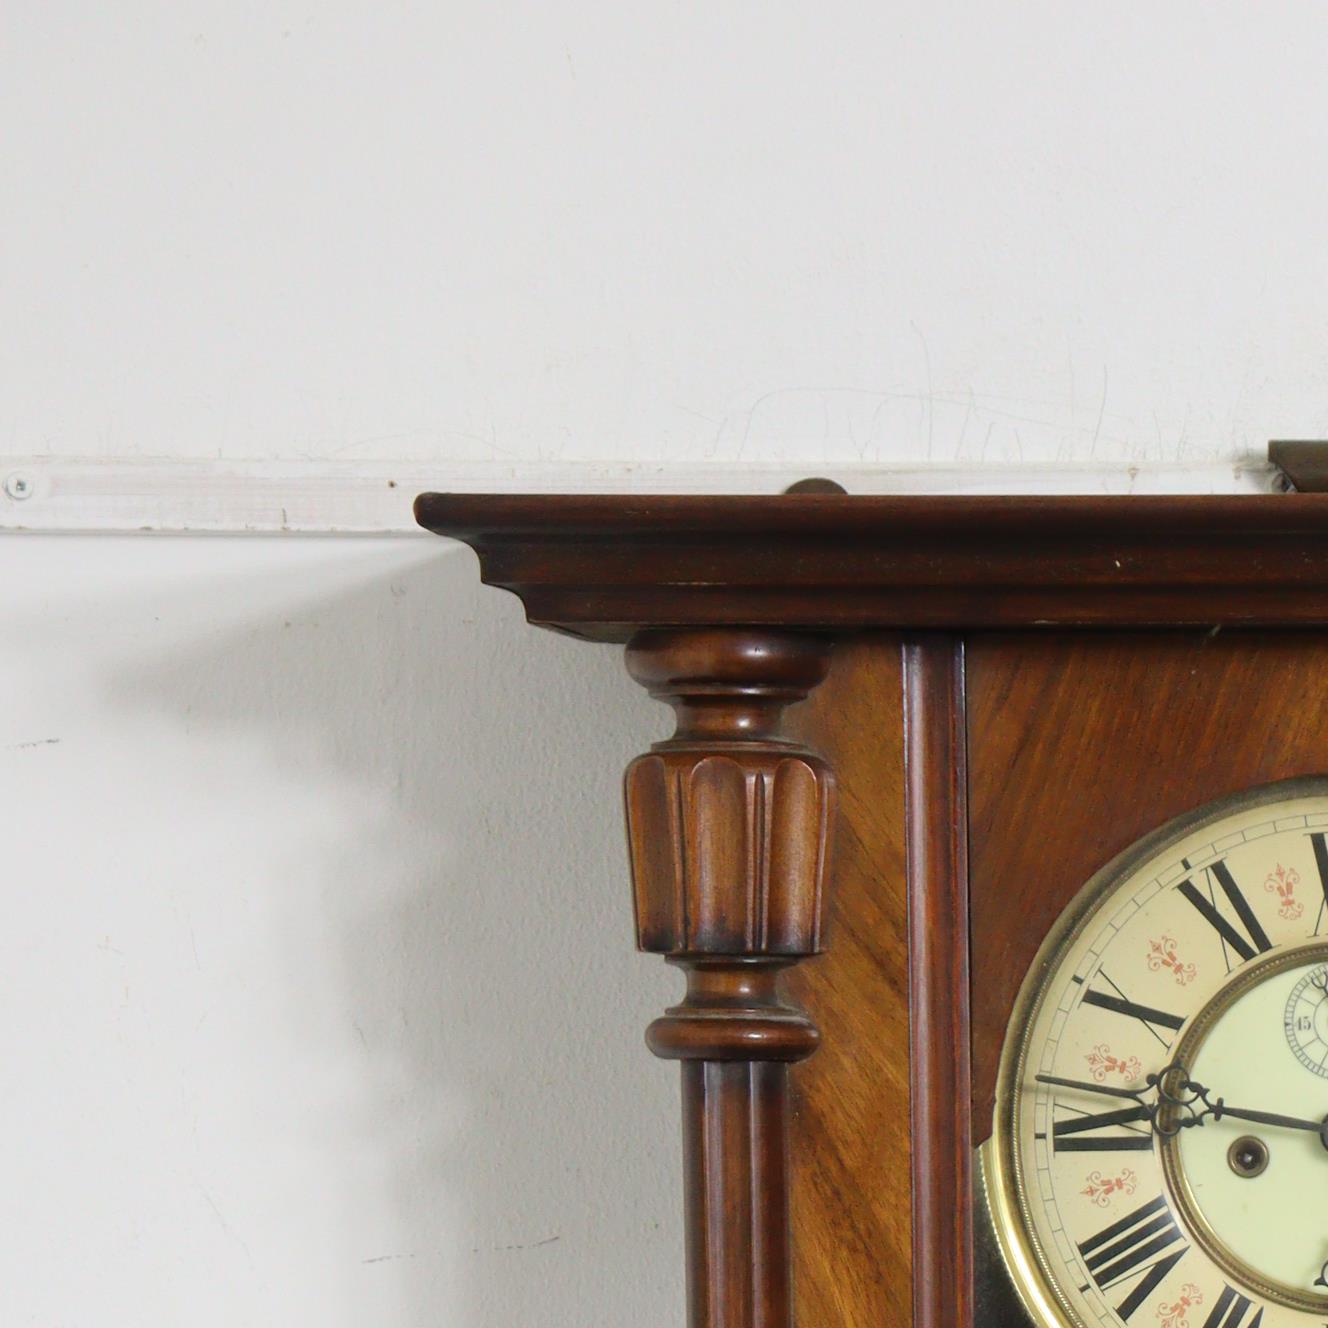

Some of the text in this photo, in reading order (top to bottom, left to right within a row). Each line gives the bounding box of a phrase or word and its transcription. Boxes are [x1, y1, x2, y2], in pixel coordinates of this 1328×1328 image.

[1173, 857, 1280, 974] XI
[1079, 969, 1188, 1049] X
[1077, 1194, 1191, 1324] VIII
